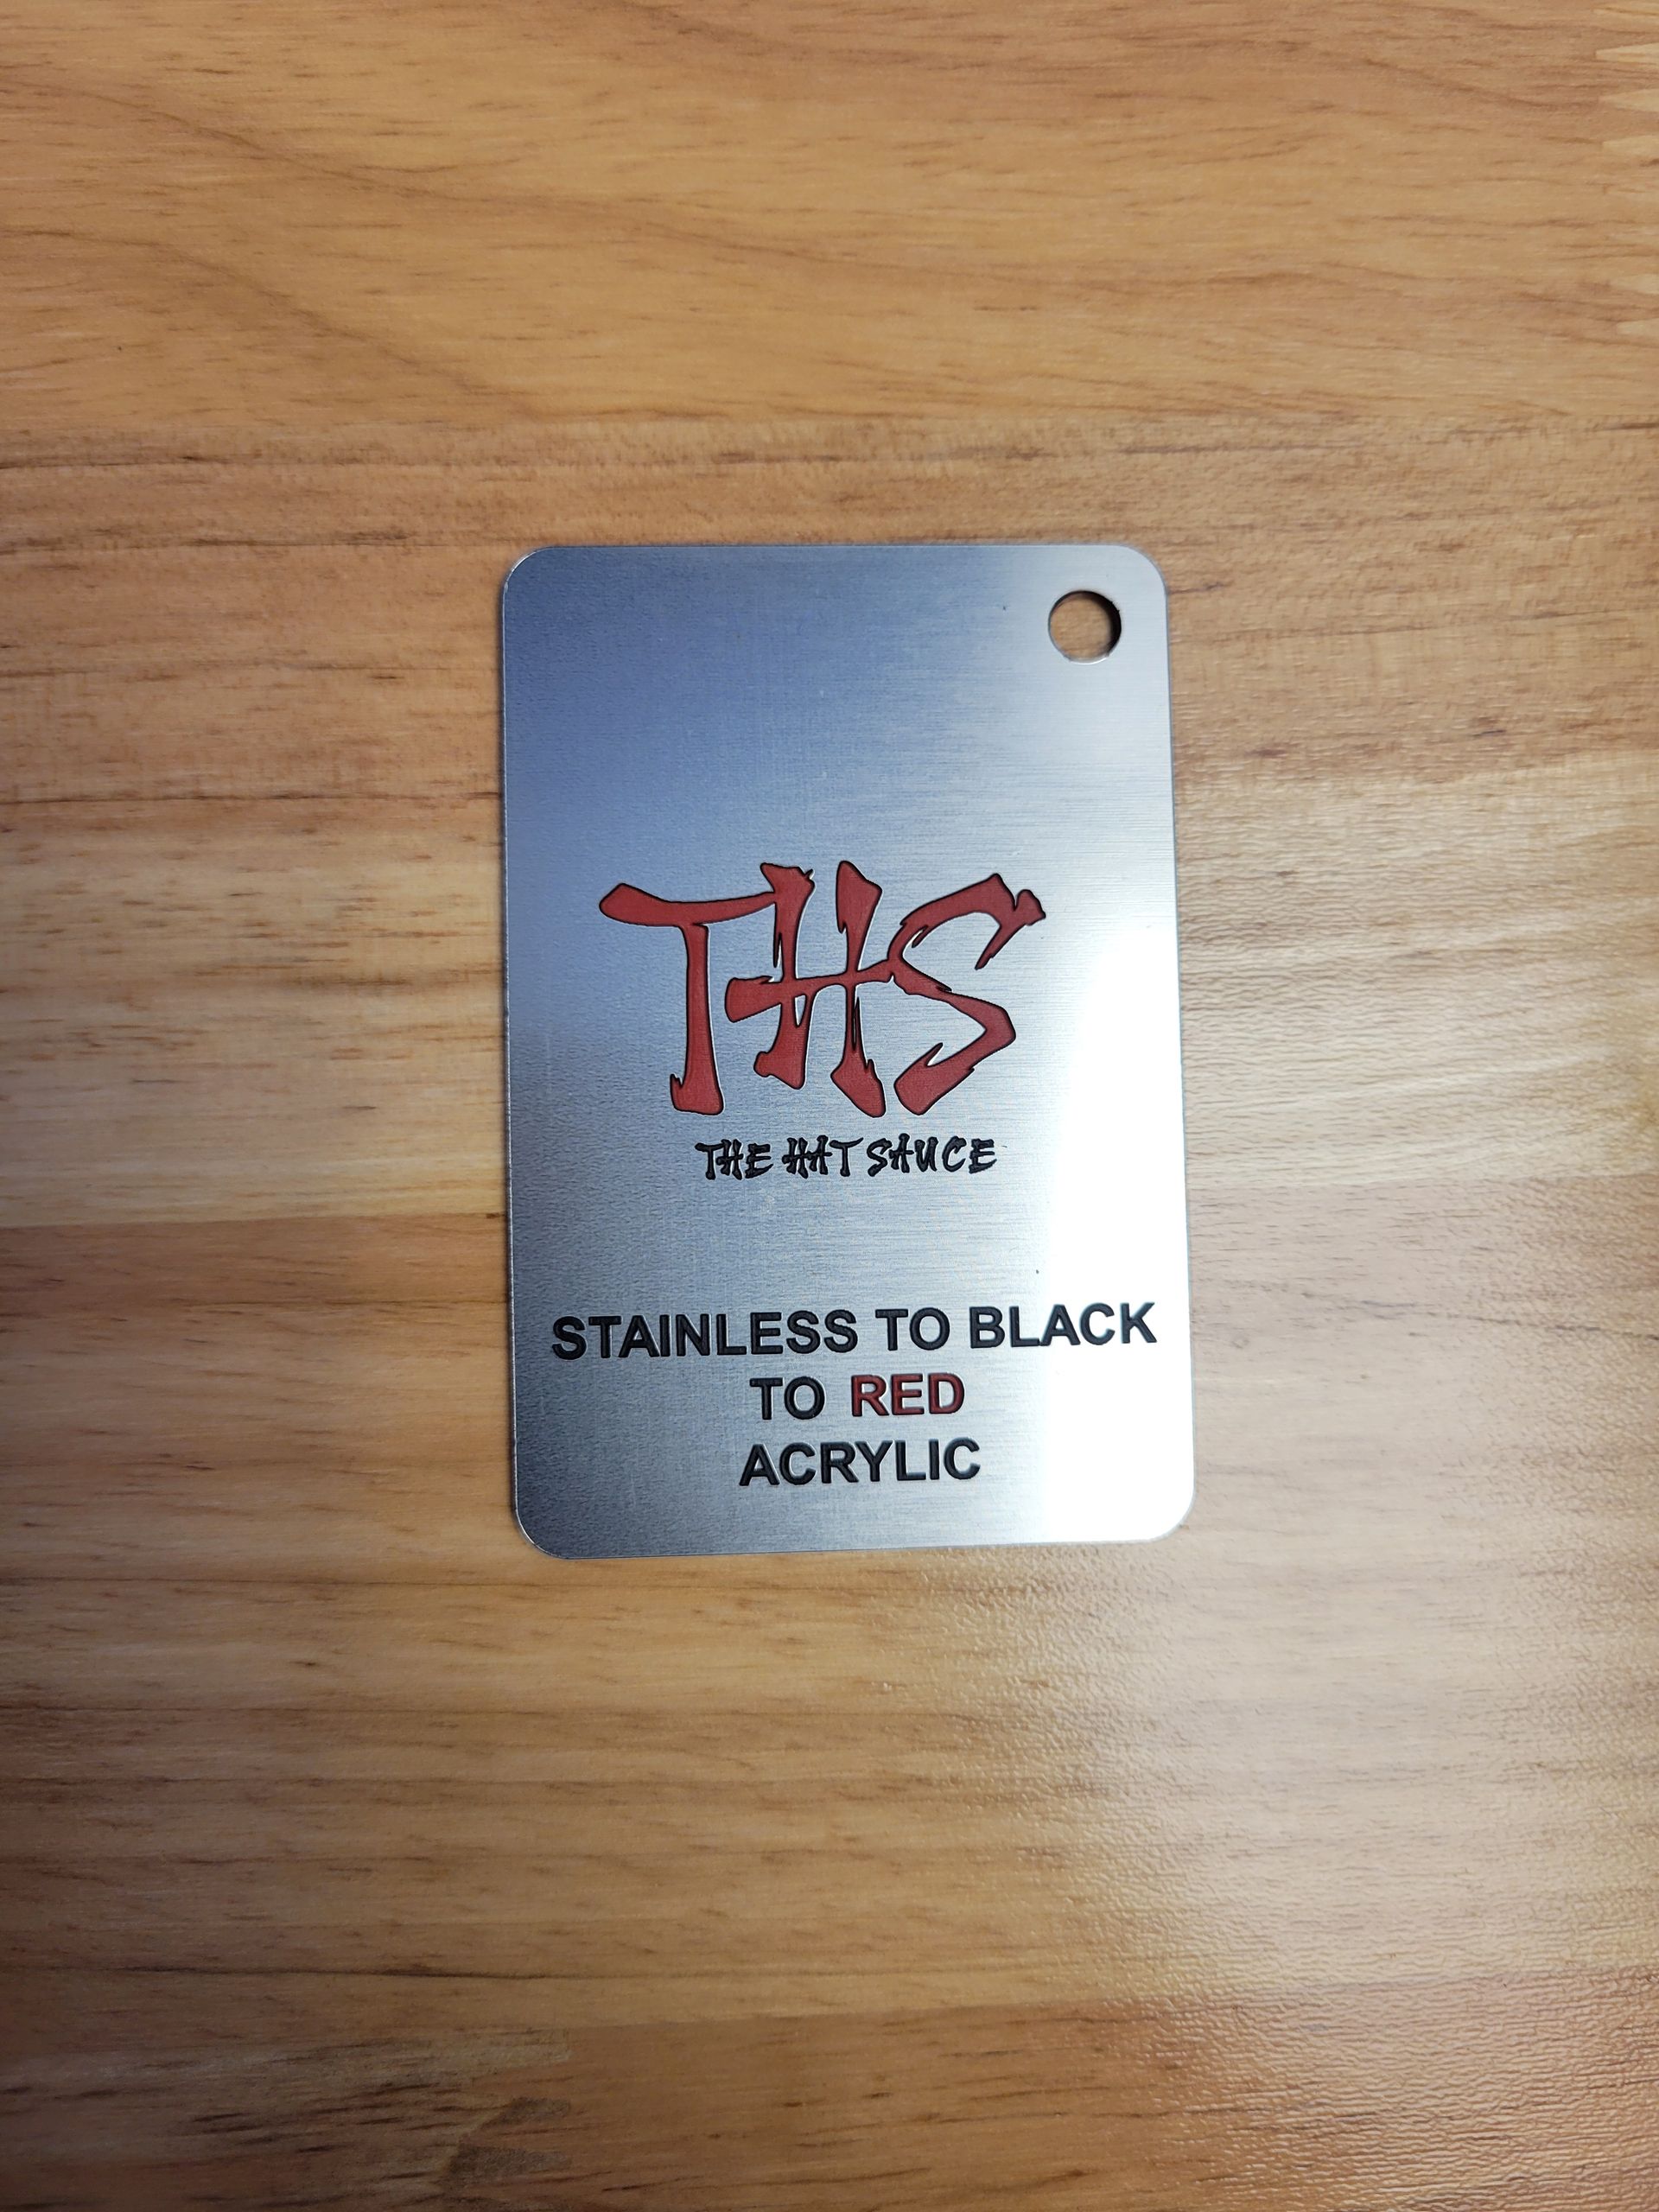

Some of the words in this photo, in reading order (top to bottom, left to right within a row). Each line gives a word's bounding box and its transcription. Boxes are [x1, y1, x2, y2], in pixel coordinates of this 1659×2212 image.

[695, 1138, 773, 1180] THE
[781, 1135, 864, 1179] HAT
[866, 1133, 997, 1177] SAUCE
[551, 1310, 859, 1361] STAINLESS
[875, 1307, 950, 1351] TO
[969, 1301, 1158, 1349] BLACK
[749, 1376, 825, 1421] TO
[851, 1372, 965, 1417] RED
[739, 1437, 981, 1487] ACRYLIC
